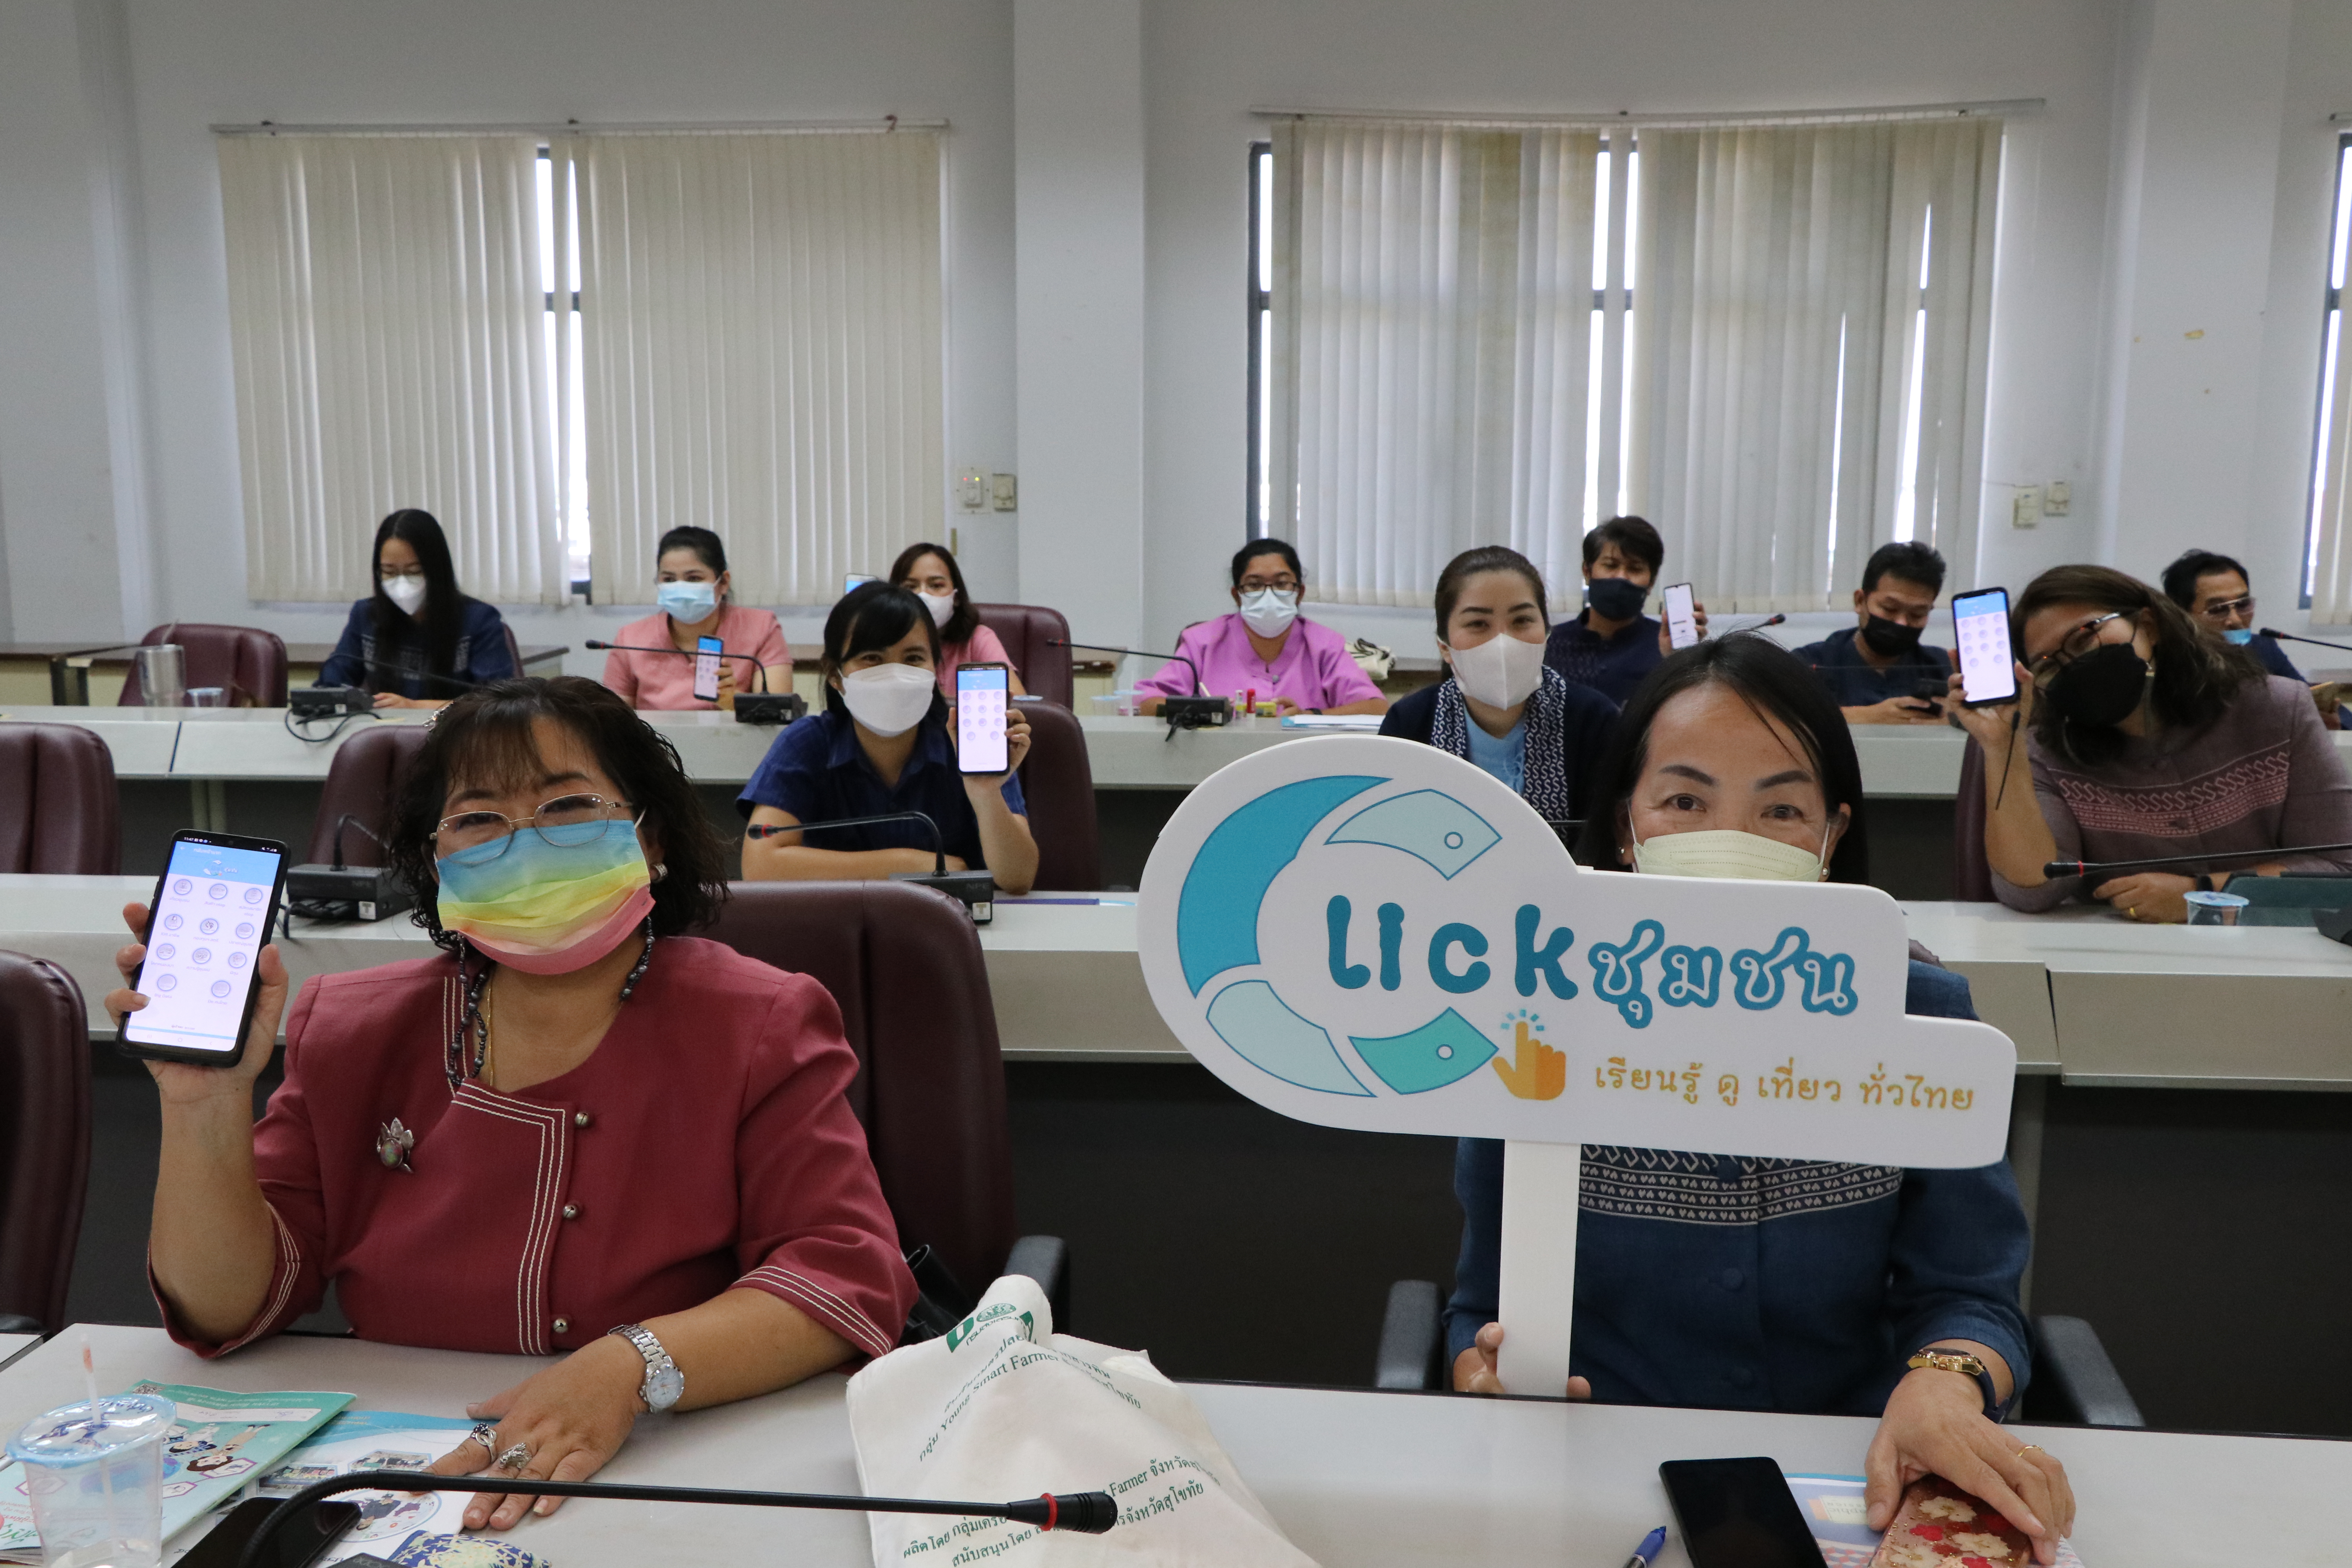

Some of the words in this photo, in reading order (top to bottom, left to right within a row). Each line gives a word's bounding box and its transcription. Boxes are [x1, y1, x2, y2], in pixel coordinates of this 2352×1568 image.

[1588, 919, 1858, 1029] ชุมชน
[1596, 1056, 1703, 1105] เรียนรู้
[1718, 1074, 1739, 1107] ดู
[1758, 1057, 1842, 1102] เที่ยว
[1859, 1063, 1974, 1111] ทั่วไทย
[940, 1395, 971, 1432] Young
[973, 1364, 1008, 1394] Smart
[1010, 1351, 1060, 1371] Farmer
[1109, 1468, 1149, 1497] Farmer
[951, 1515, 1007, 1543] กลุ่มเครอ
